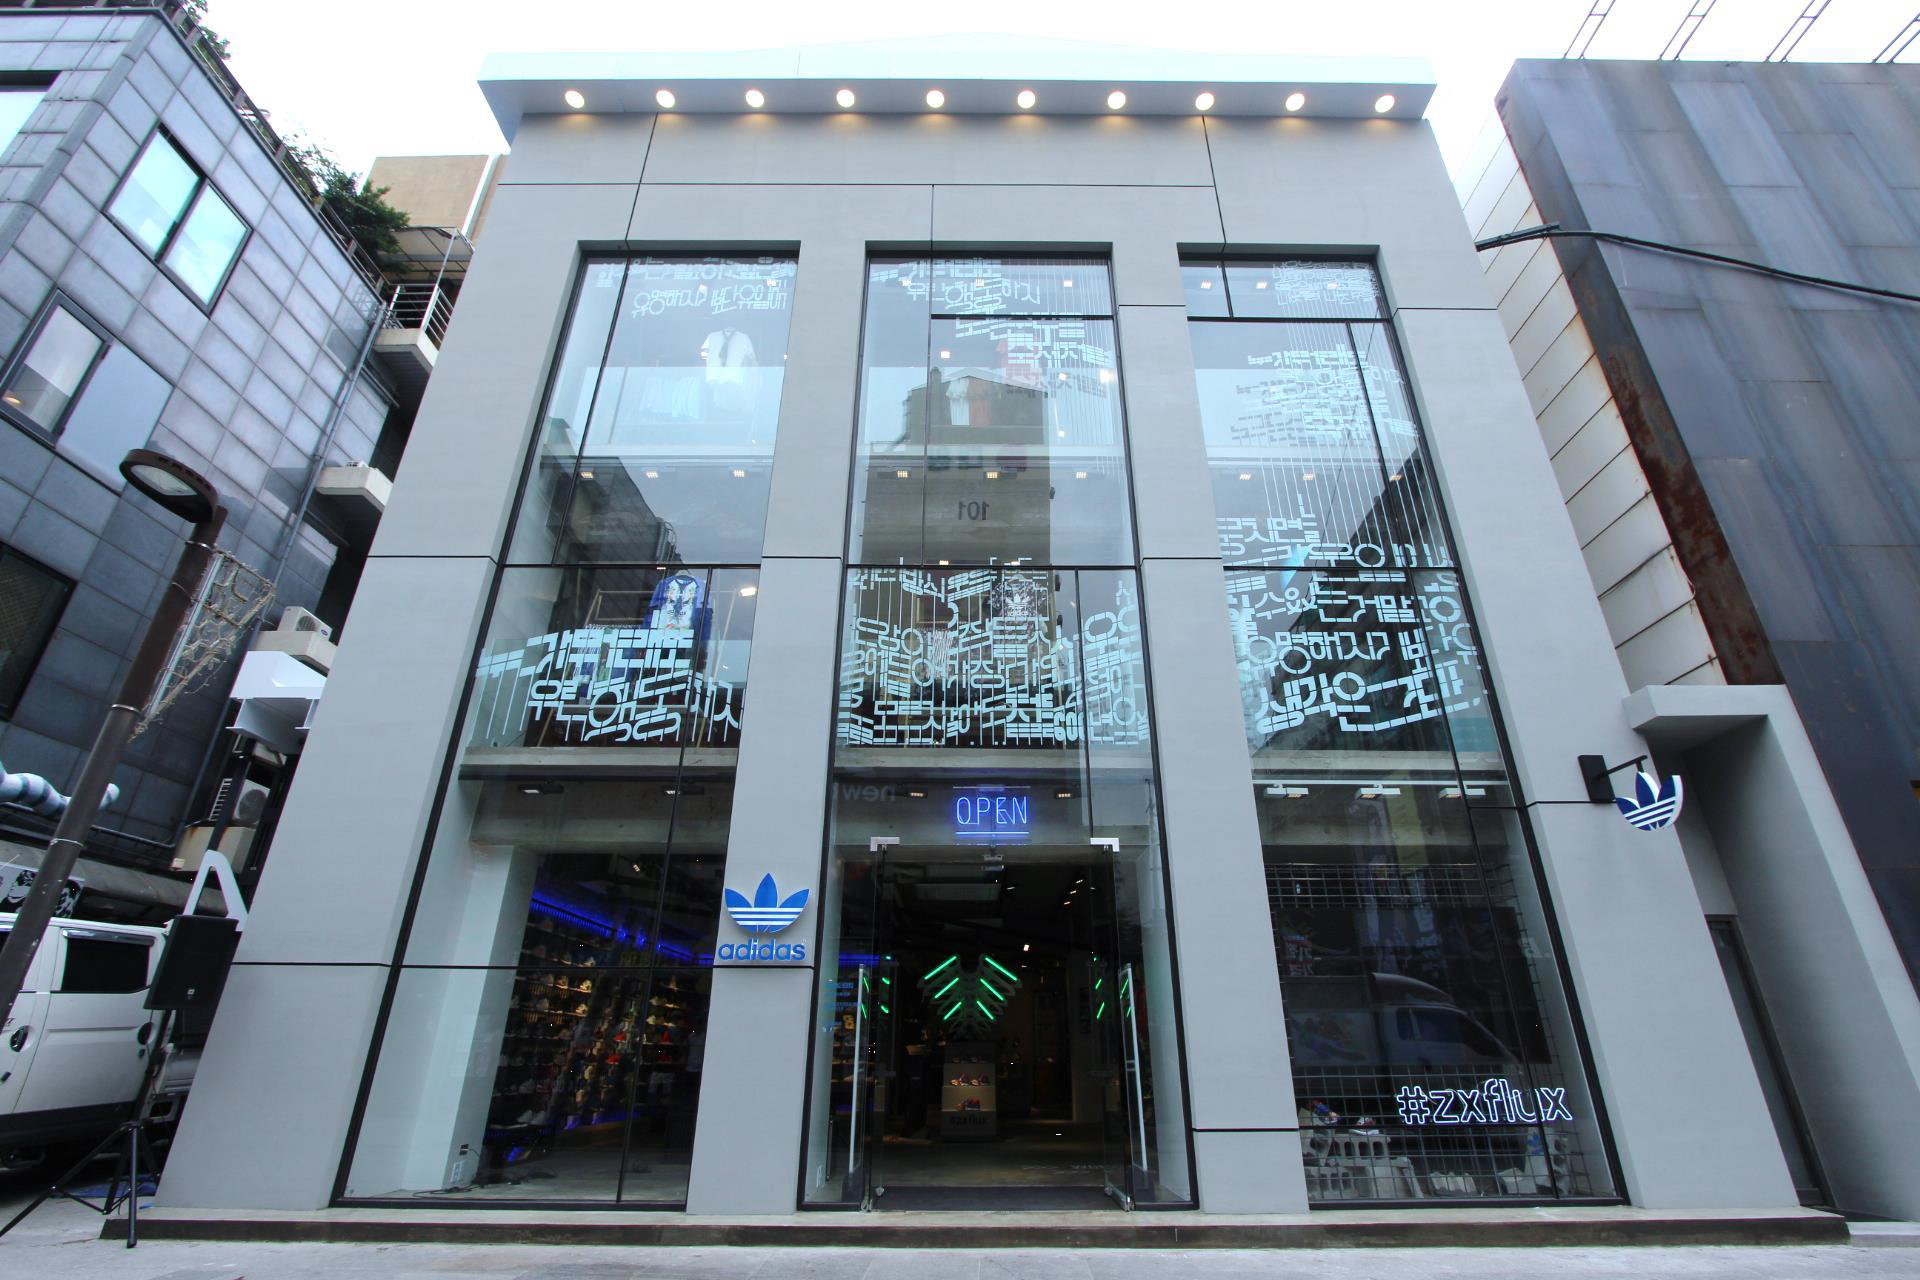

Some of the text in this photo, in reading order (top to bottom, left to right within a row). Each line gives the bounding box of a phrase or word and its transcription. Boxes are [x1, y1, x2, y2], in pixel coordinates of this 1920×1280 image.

[955, 796, 1028, 825] OPEN
[718, 938, 806, 961] adidas
[1396, 1078, 1573, 1125] #zxflux
